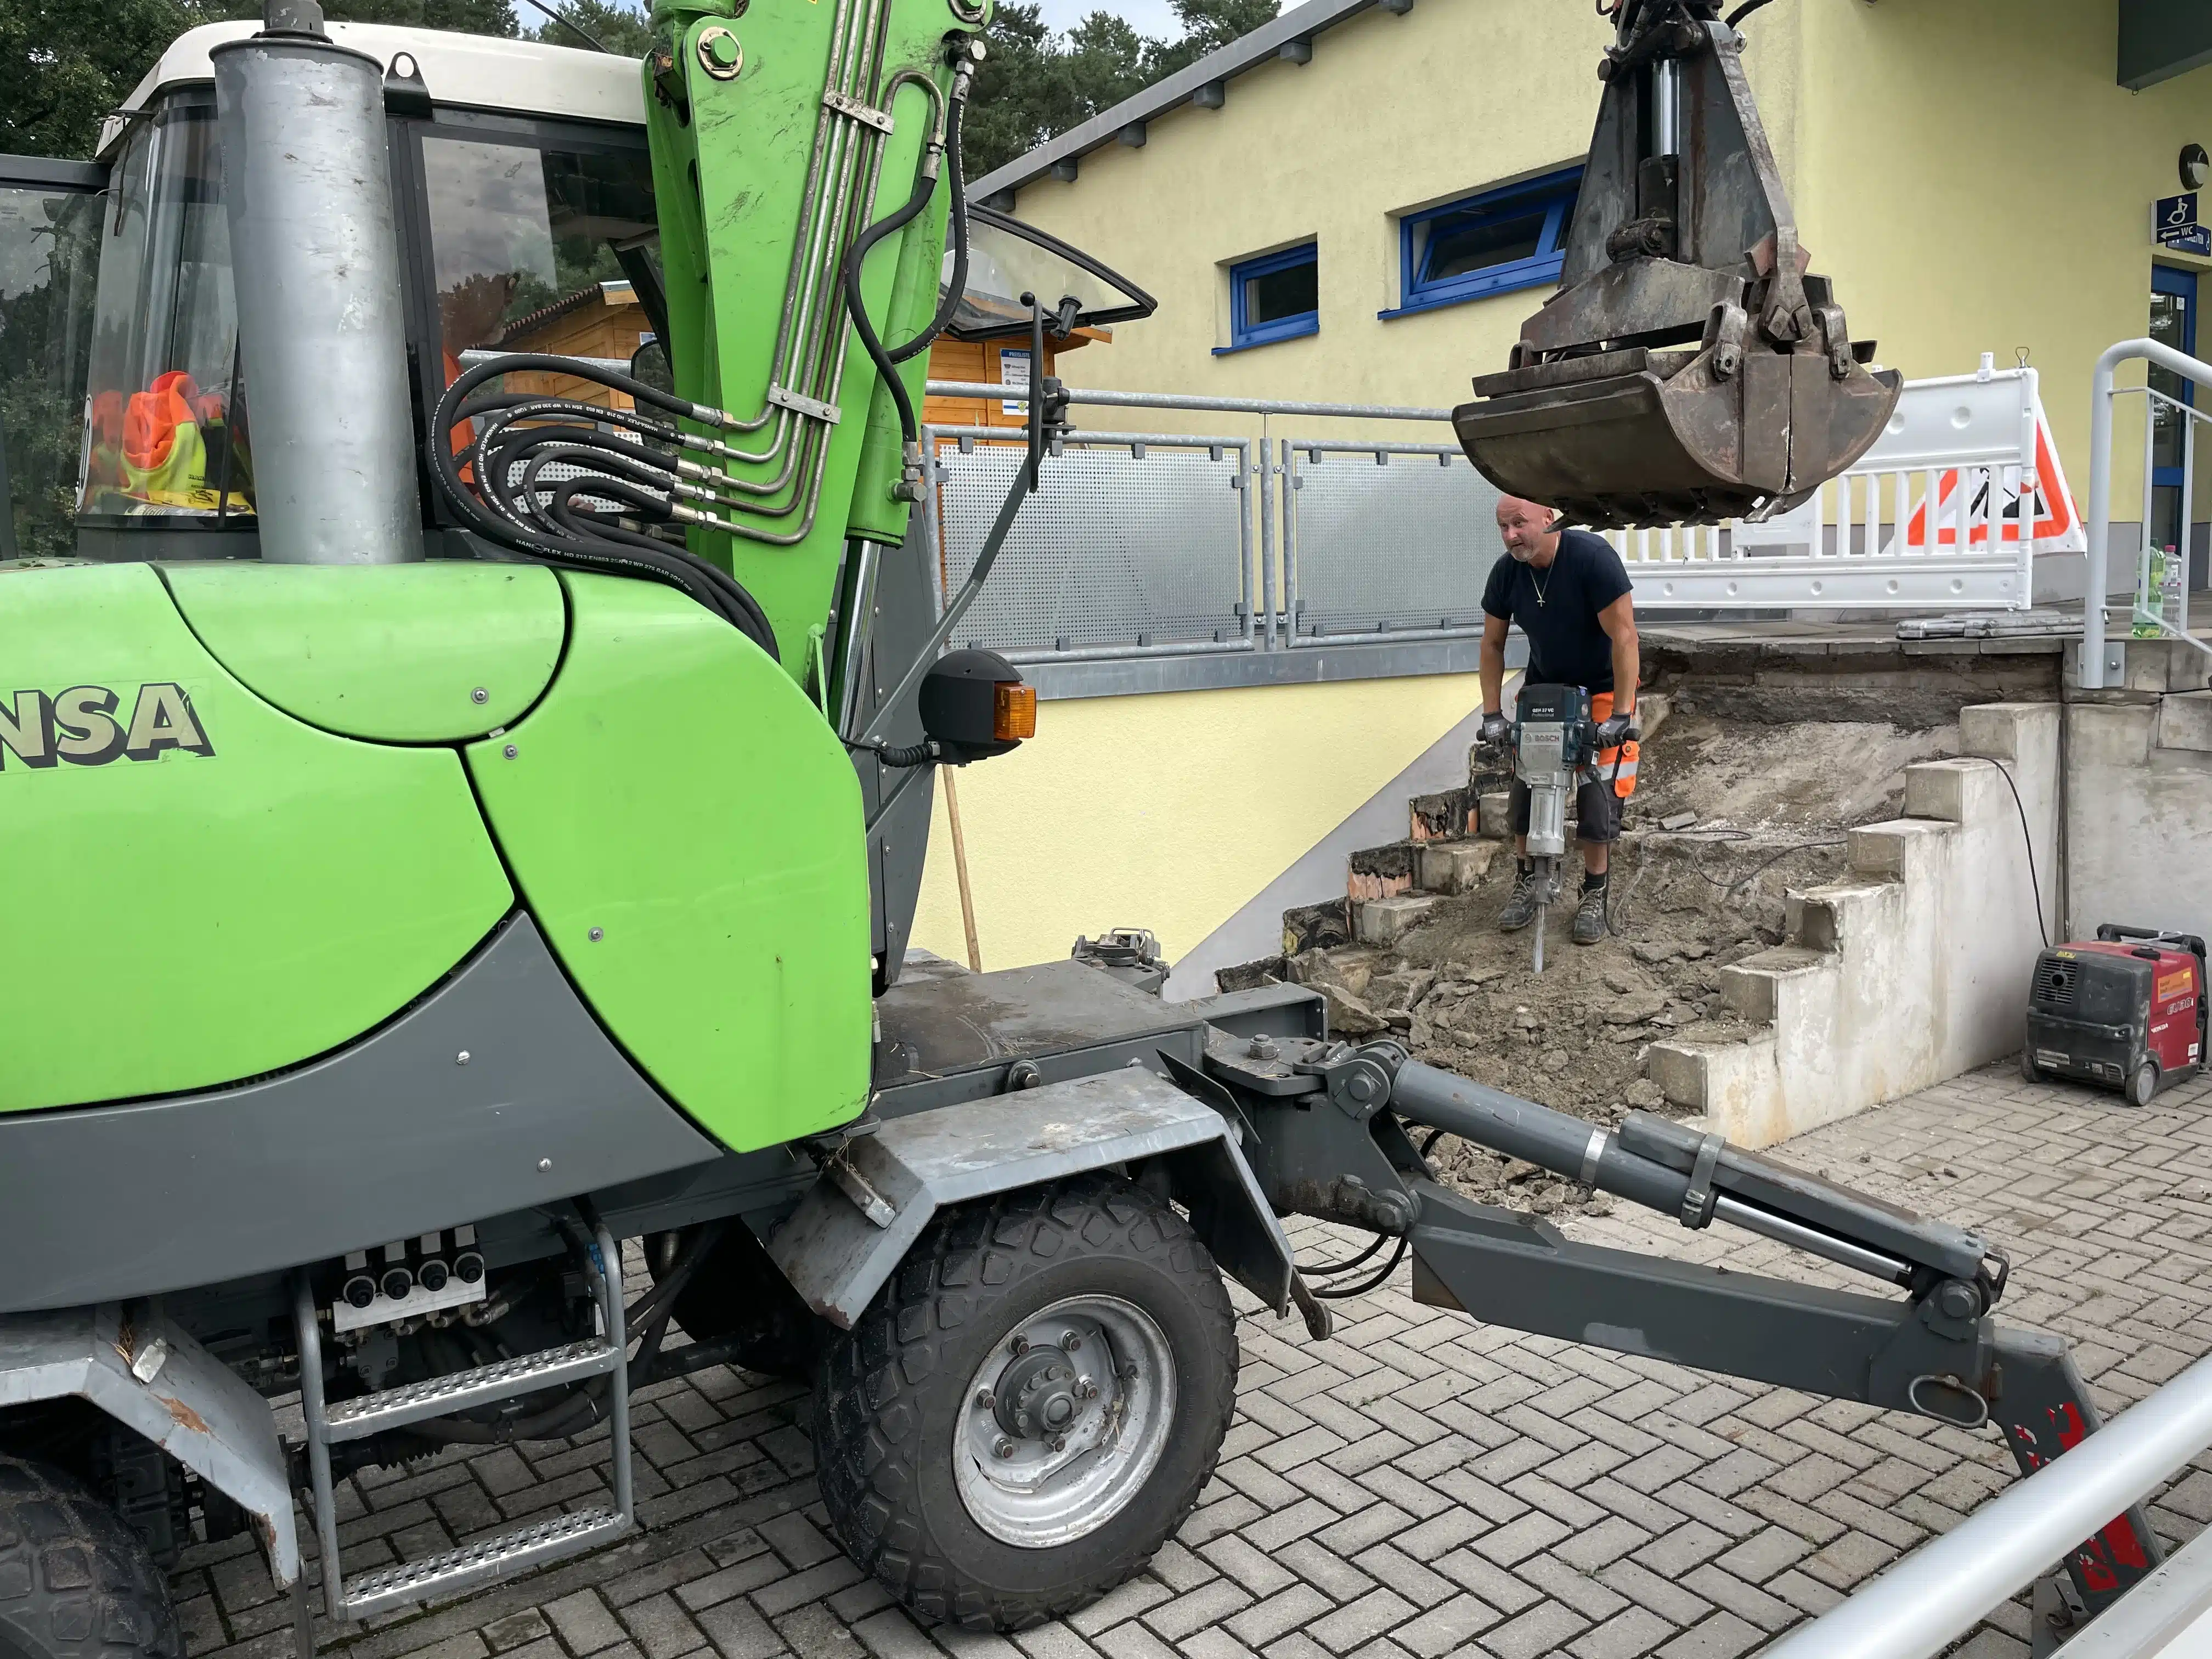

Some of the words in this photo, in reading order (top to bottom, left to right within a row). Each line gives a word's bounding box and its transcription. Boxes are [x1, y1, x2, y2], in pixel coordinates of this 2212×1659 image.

[2181, 226, 2193, 236] WC
[628, 418, 658, 431] HANSA-FLEX
[480, 422, 499, 452] HANSA-FLEX
[478, 453, 484, 461] HD
[490, 495, 500, 505] 2SN
[516, 538, 562, 555] HANSFLEX
[656, 567, 669, 576] BAR
